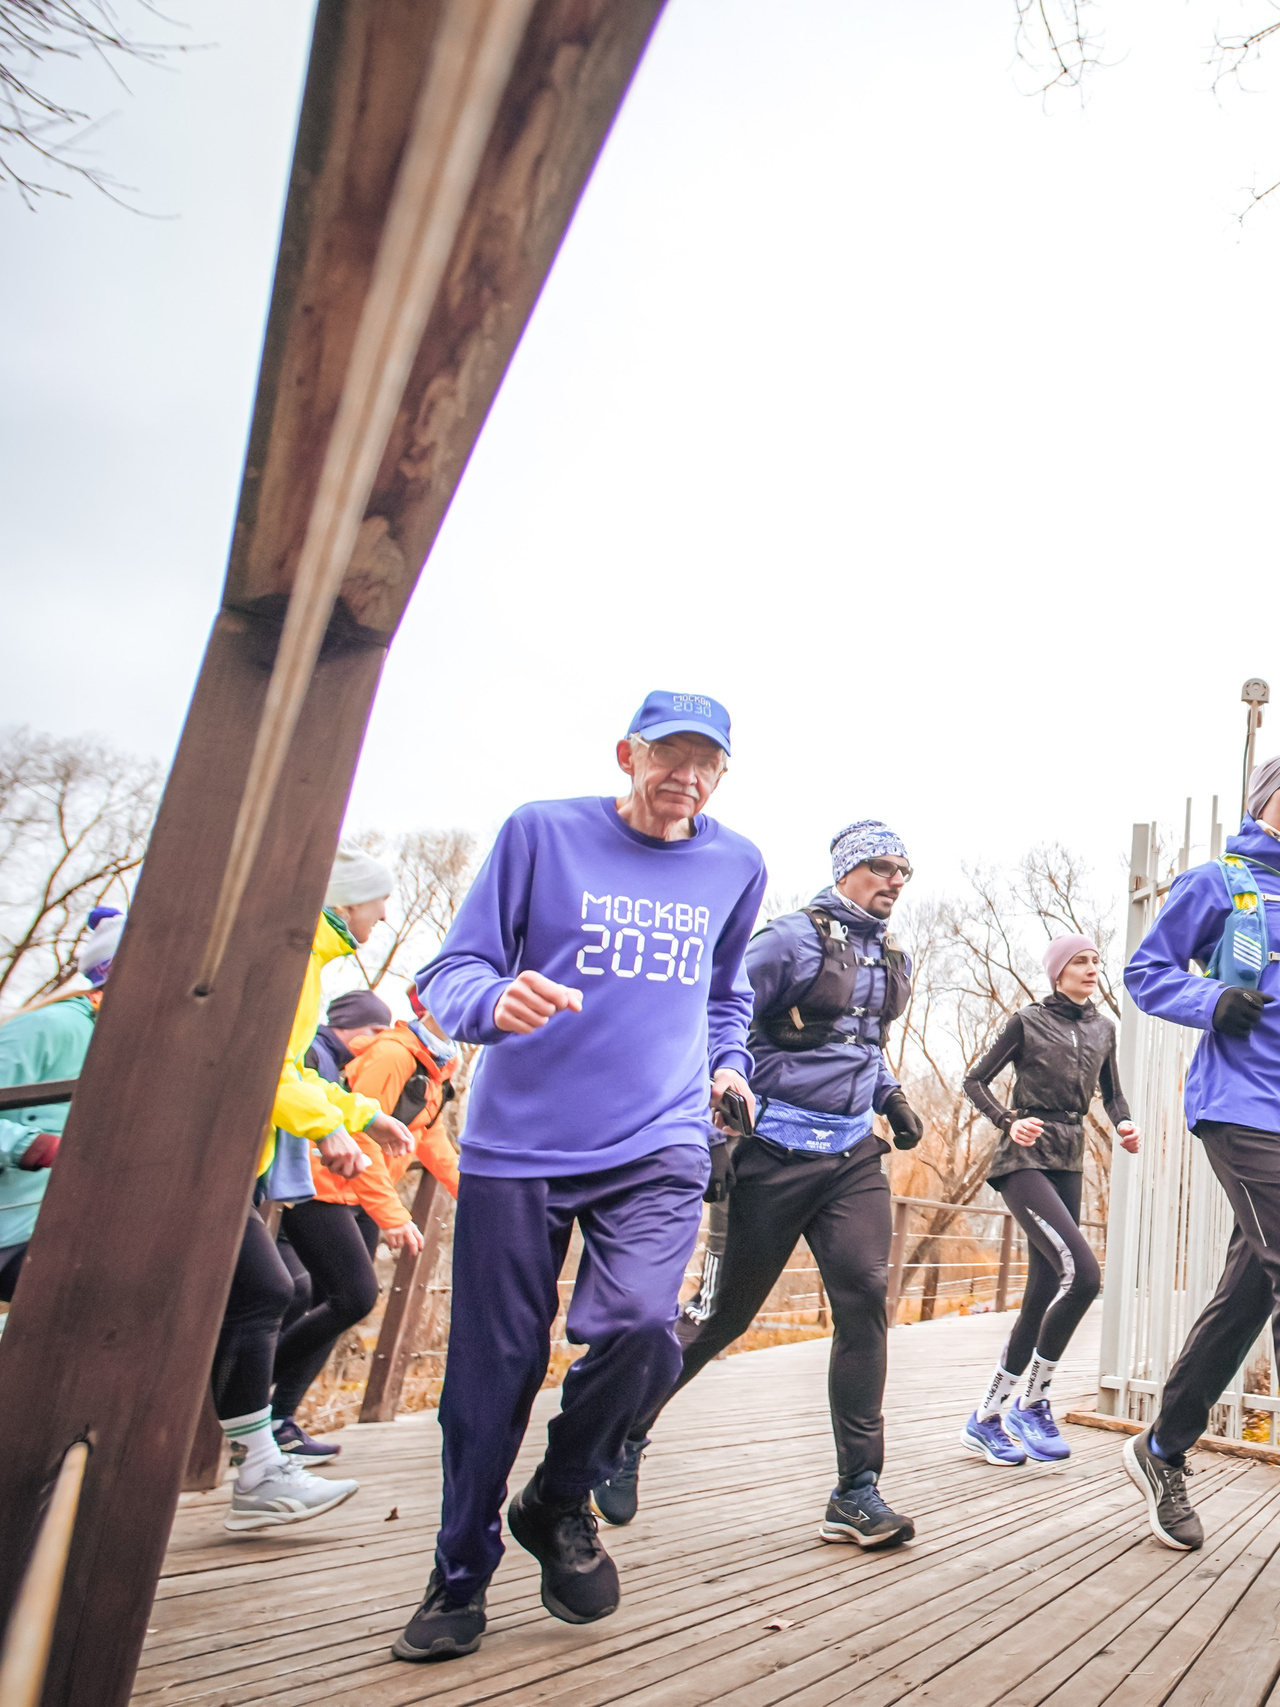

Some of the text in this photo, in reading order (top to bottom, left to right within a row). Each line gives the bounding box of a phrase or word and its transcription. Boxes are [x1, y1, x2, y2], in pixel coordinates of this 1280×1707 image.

[673, 694, 711, 708] МОСКВА
[673, 701, 711, 718] 2030
[581, 891, 710, 936] МОСКВА
[576, 924, 704, 986] 2030
